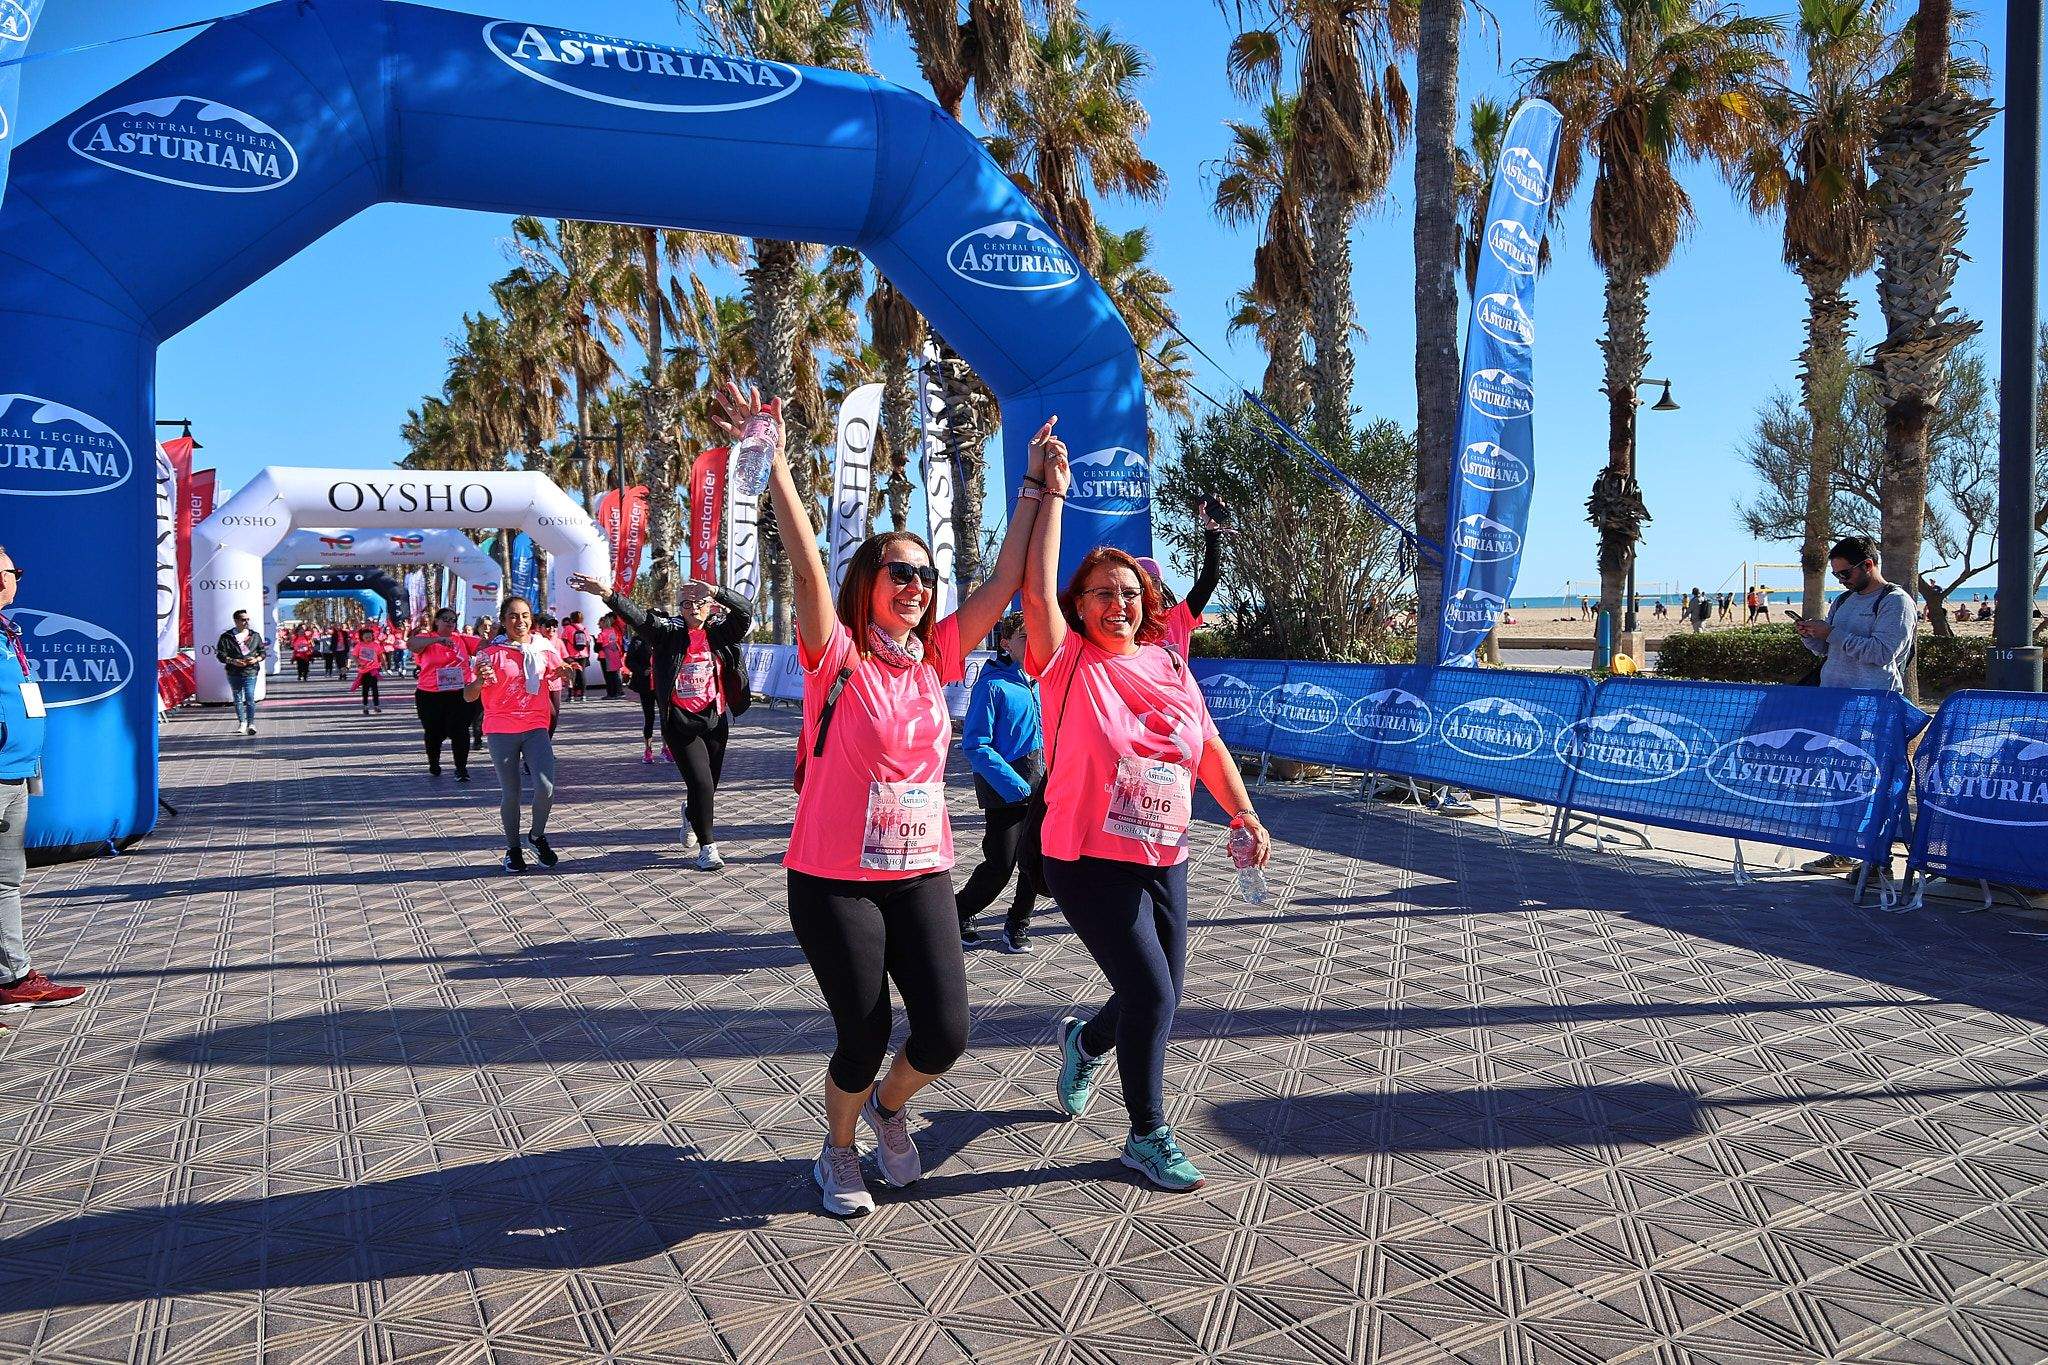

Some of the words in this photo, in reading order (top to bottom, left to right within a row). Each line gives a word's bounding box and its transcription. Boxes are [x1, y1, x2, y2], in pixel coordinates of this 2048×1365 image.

[511, 26, 785, 88] ASTURIANA
[122, 120, 197, 135] CENTRAL
[204, 125, 278, 150] LECHERA
[84, 122, 282, 180] ASTURIANA
[958, 243, 1076, 276] ASTURIANA
[984, 243, 1028, 251] CENTRAL
[1471, 380, 1531, 411] ASTURIANA
[40, 430, 114, 449] LECHERA
[0, 443, 121, 479] URIANA
[1083, 470, 1126, 478] CENTRAL
[1462, 454, 1521, 483] ASTURIANA
[328, 481, 493, 513] OYSHO
[699, 469, 716, 550] Santander
[221, 515, 277, 527] OYSHO
[624, 501, 642, 566] Santander
[734, 501, 757, 602] OYSH
[199, 579, 251, 591] OYSHO
[286, 574, 365, 583] VOLVO
[42, 643, 115, 654] LECHERA
[1995, 650, 2014, 660] 116
[28, 658, 122, 683] RIANA
[1203, 697, 1247, 710] URIANA
[1263, 695, 1332, 723] ASTURIANA
[1350, 707, 1425, 734] ASTURIANA
[1447, 715, 1533, 750] ASTURIANA
[1562, 732, 1676, 772] ASTURIANA
[1746, 751, 1800, 763] CENTRAL
[1715, 751, 1866, 794] ASTURIANA
[1926, 763, 2048, 805] ASTURIA
[1141, 796, 1172, 813] 016
[1144, 812, 1160, 821] 3791
[899, 822, 927, 837] 016
[1113, 823, 1143, 835] OYSHO
[872, 857, 902, 866] OYSHO
